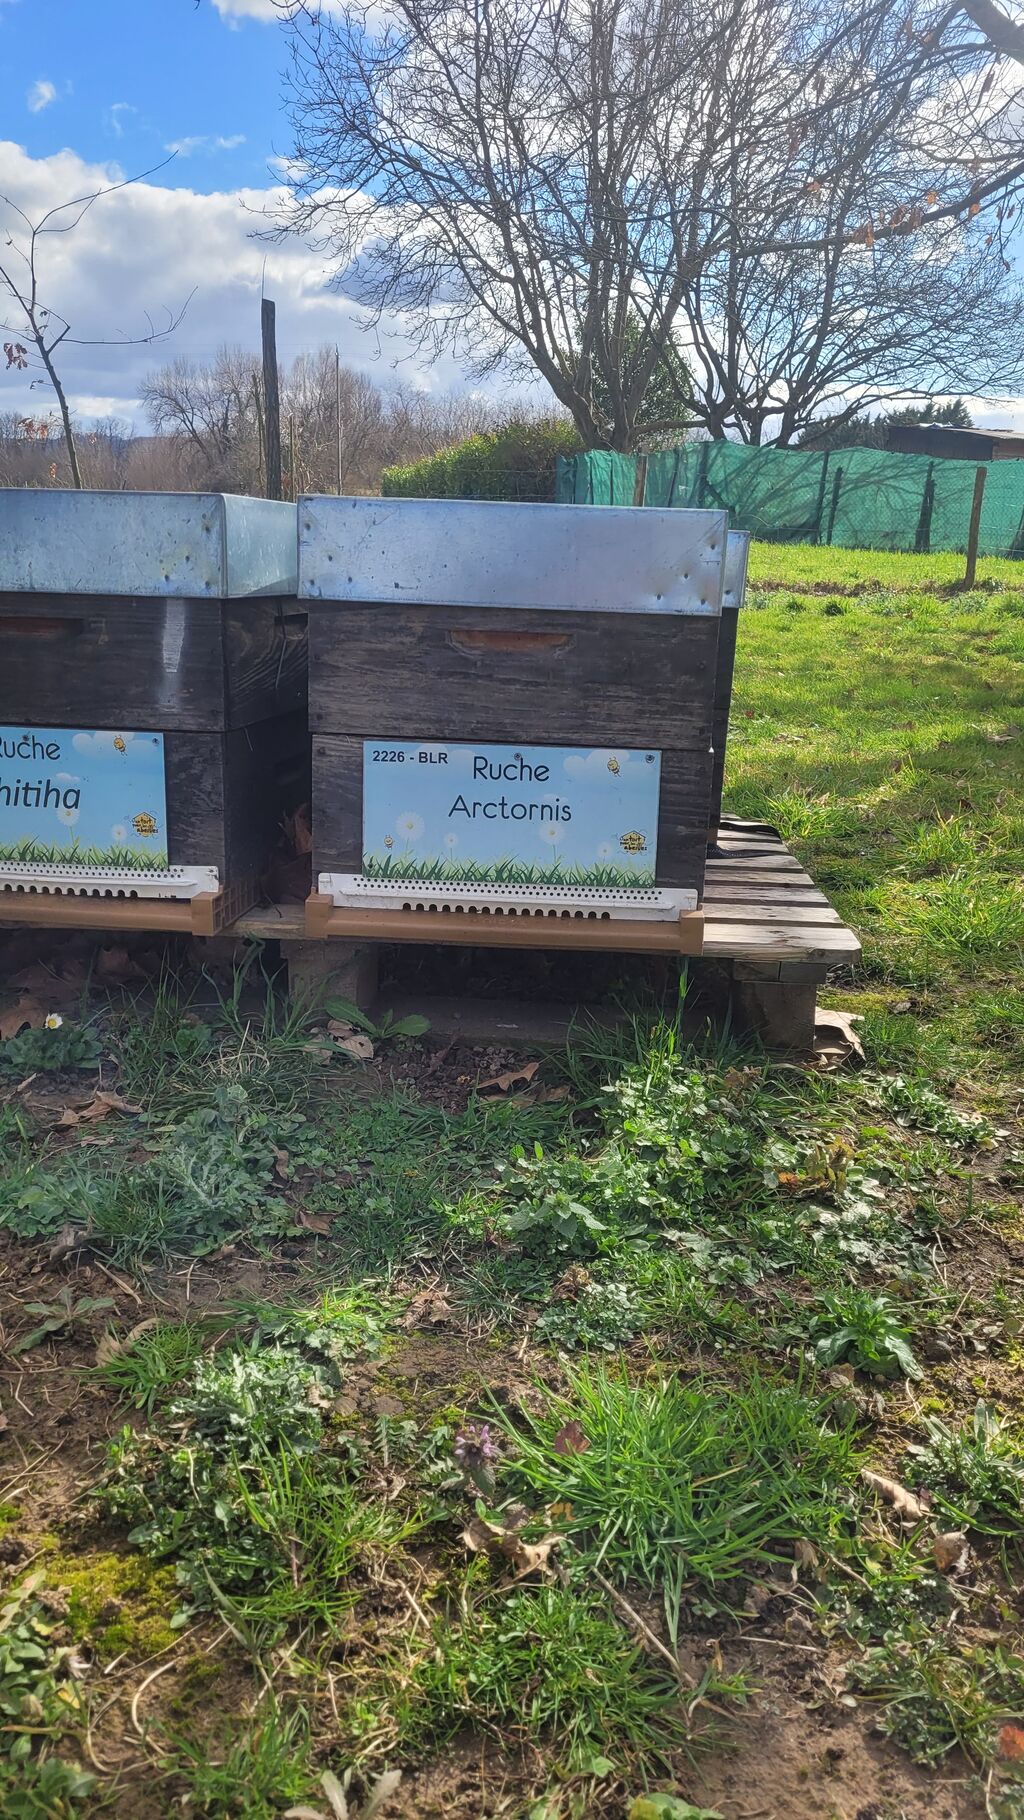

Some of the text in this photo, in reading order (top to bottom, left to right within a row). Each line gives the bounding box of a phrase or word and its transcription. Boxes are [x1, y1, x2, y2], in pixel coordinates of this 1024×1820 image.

[0, 735, 61, 760] uche
[372, 750, 405, 763] 2226
[418, 751, 449, 764] BLR
[473, 756, 550, 782] Ruche
[448, 794, 572, 822] Arctornis
